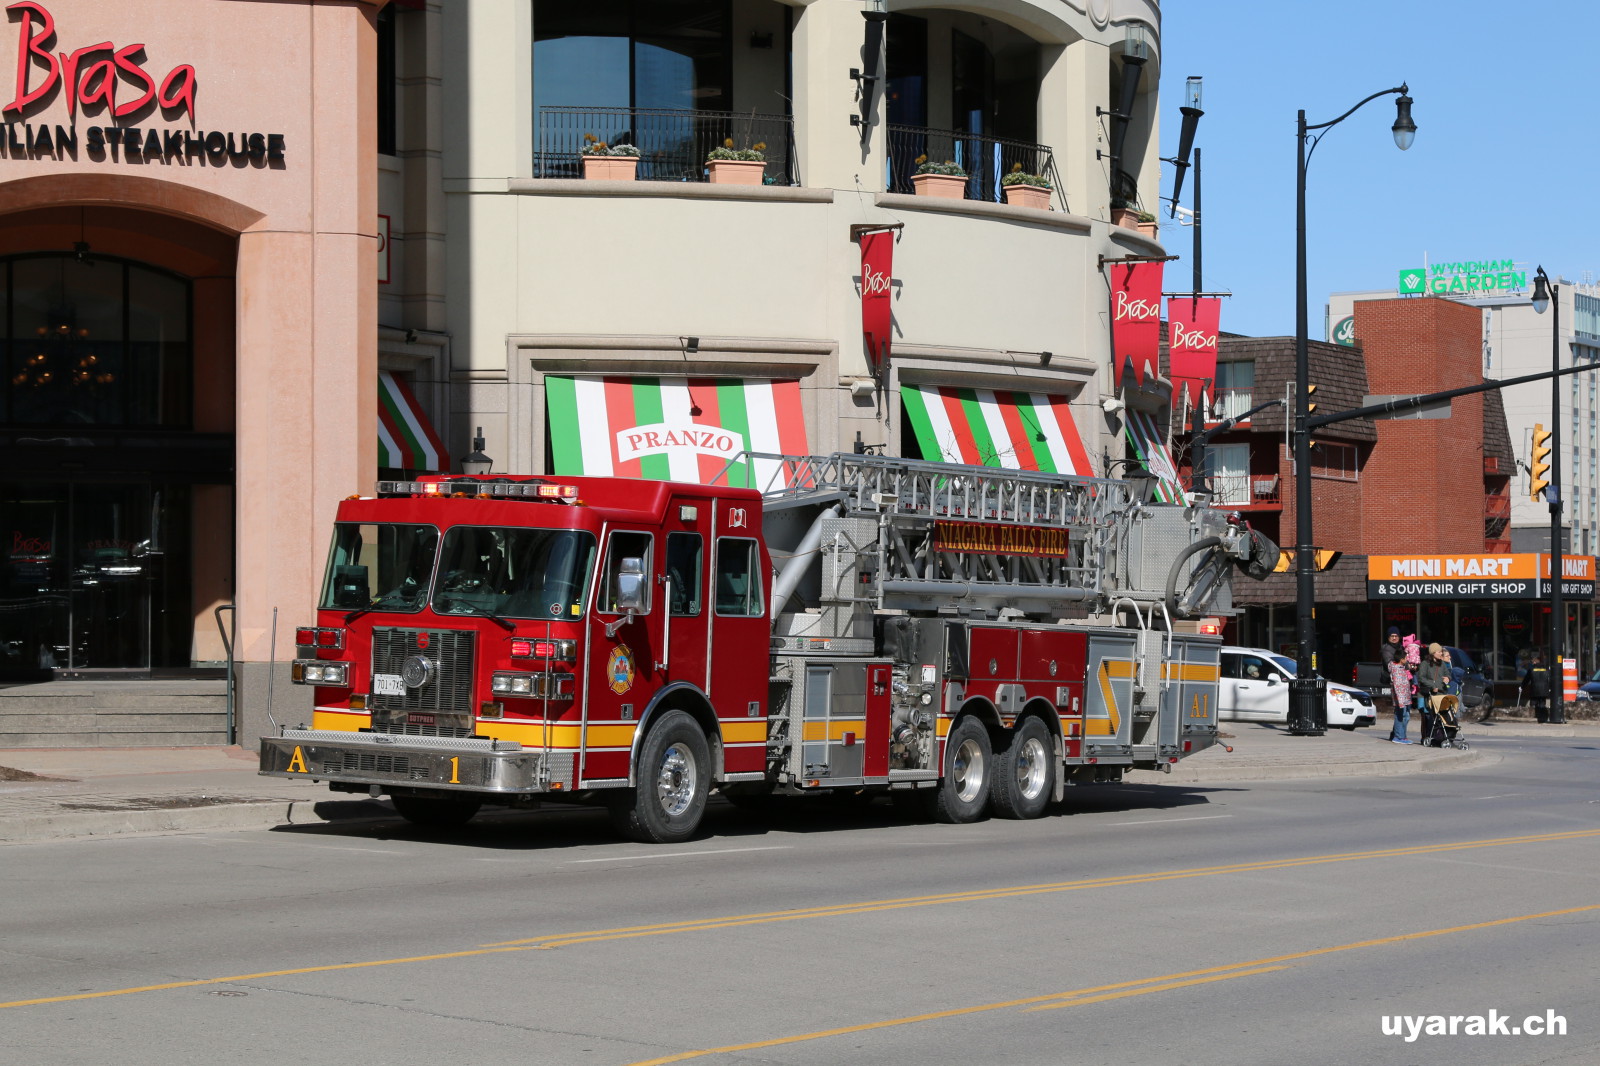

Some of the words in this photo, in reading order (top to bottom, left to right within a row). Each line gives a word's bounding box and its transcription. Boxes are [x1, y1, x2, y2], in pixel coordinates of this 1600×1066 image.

[2, 1, 195, 120] Brasa
[86, 126, 285, 160] STEAKHOUSE
[1430, 259, 1513, 275] WYNDHAM
[863, 263, 891, 295] Brasa
[1430, 271, 1526, 294] GARDEN
[1115, 290, 1159, 320] Brasa
[1171, 321, 1217, 349] Brasa
[626, 429, 733, 452] PRANZO
[938, 522, 997, 551] NIAGARA
[1000, 526, 1036, 553] FALLS
[1039, 528, 1066, 555] FIRE
[1391, 559, 1441, 577] MINI
[1446, 558, 1513, 576] MART
[1565, 559, 1589, 577] MART
[1378, 584, 1387, 595] &
[1389, 583, 1454, 595] SOUVENIR
[1458, 583, 1487, 594] GIFT
[1490, 583, 1526, 594] SHOP
[1570, 584, 1580, 594] GIFT
[1580, 584, 1593, 594] SHOP
[1460, 616, 1492, 627] OPEN
[377, 679, 388, 690] 701
[1190, 692, 1209, 718] A1
[286, 745, 308, 774] A
[448, 756, 461, 784] 1
